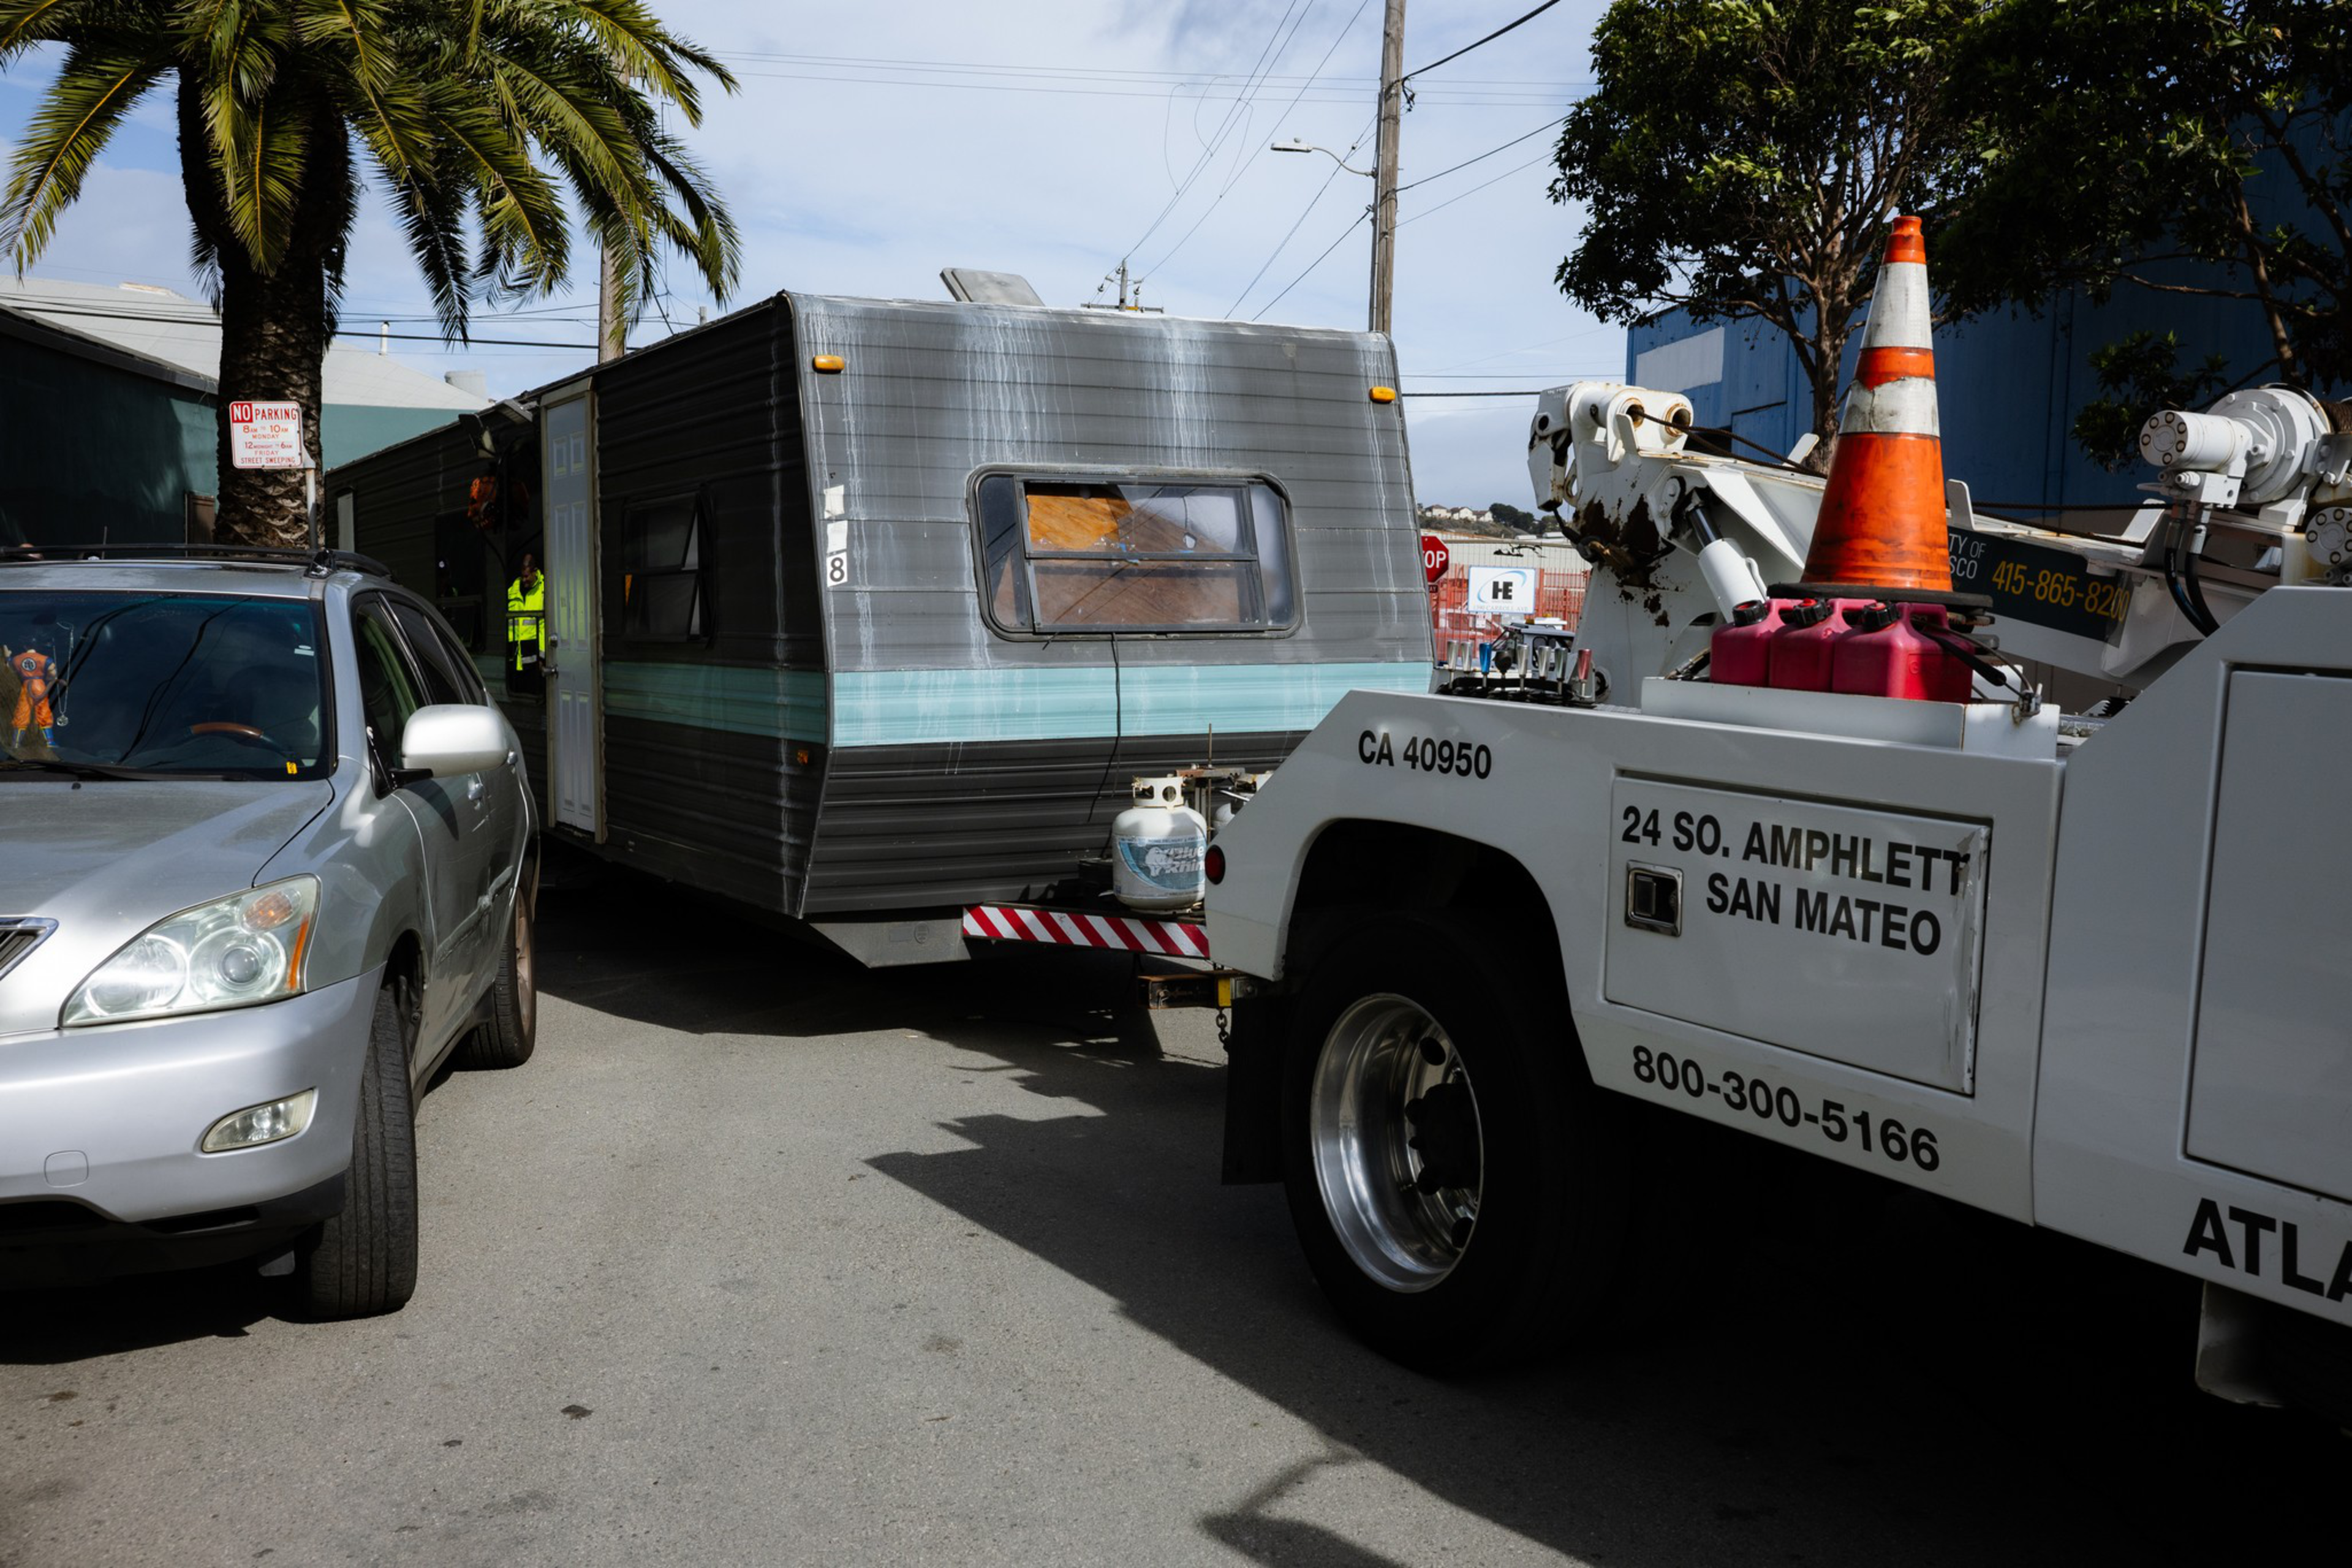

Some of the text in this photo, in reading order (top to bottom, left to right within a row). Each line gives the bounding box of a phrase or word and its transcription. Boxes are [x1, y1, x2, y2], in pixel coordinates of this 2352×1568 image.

[233, 404, 297, 421] NO PARKING
[1949, 533, 1986, 559] TY OF
[830, 557, 845, 582] 8
[1424, 550, 1446, 568] OP
[1949, 555, 1978, 579] SCO
[1492, 581, 1513, 600] HE
[1992, 560, 2130, 622] 415-865-8200
[1358, 729, 1492, 779] CA 40950
[1622, 805, 1971, 895] 24 SO. AMPHLETT
[1165, 859, 1204, 873] Rhin
[1706, 872, 1941, 956] SAN MATEO
[1633, 1045, 1940, 1172] 800-300-5166
